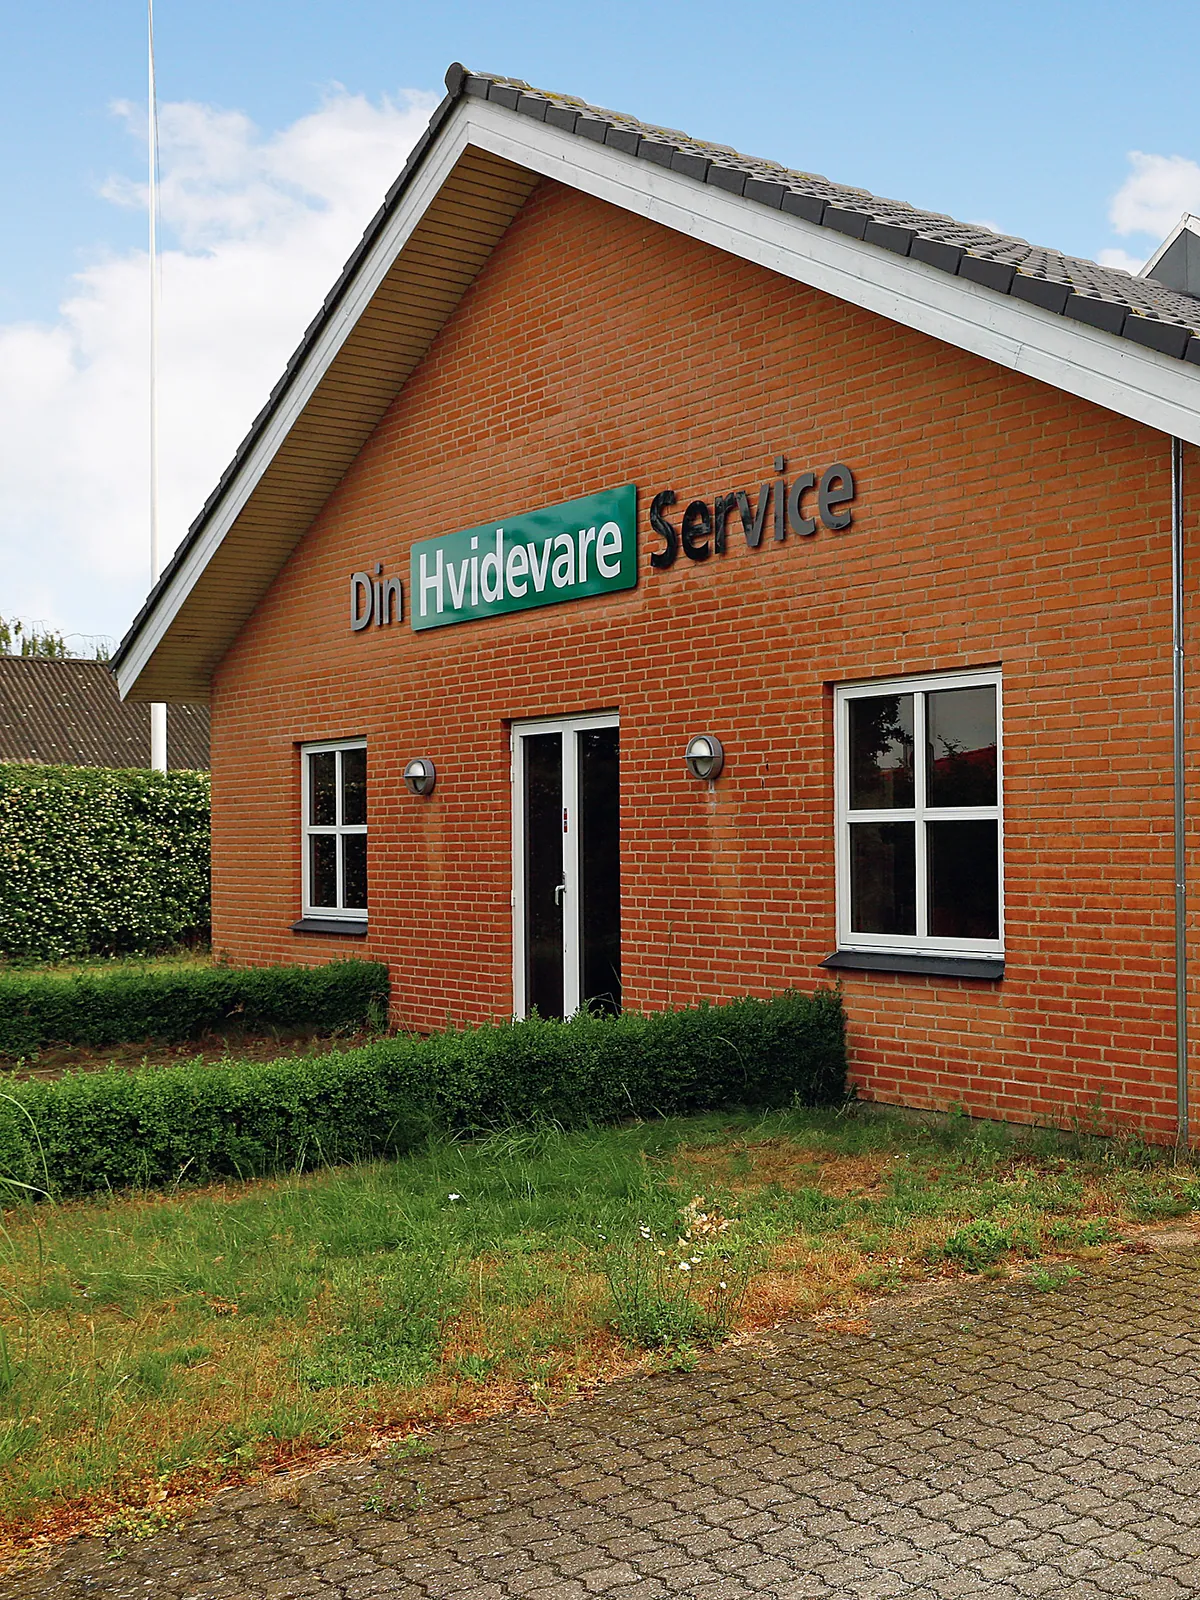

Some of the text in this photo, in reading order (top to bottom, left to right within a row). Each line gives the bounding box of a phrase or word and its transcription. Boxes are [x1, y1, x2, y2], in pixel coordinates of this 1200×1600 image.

[350, 454, 854, 631] Din Hvidevare Service
